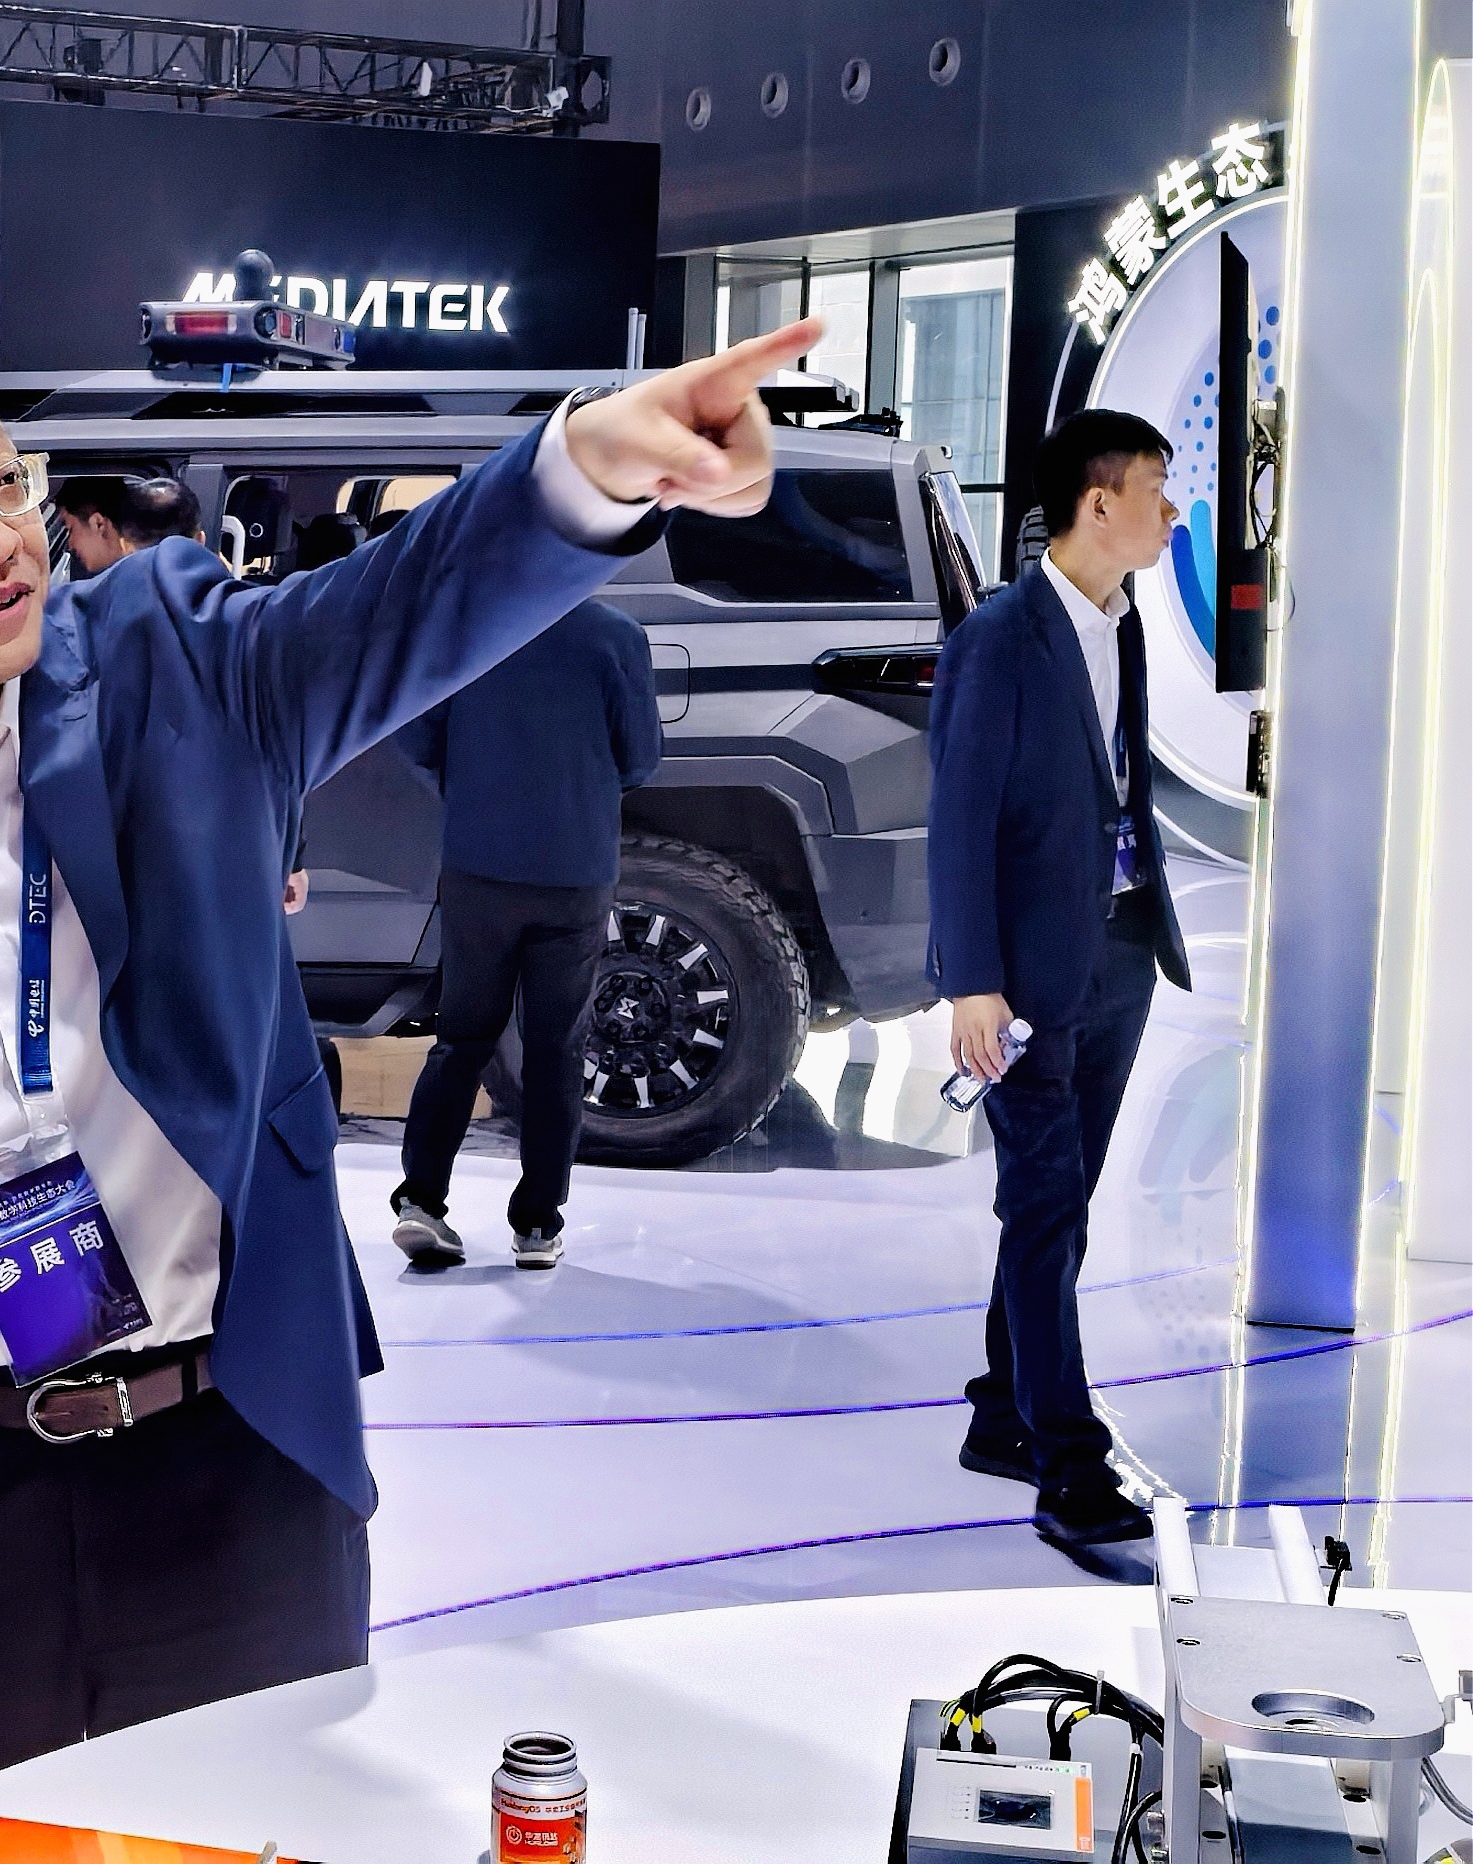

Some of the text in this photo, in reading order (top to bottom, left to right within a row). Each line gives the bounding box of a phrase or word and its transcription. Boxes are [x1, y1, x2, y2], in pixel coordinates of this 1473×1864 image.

[1068, 121, 1270, 346] 鸿蒙生态
[182, 272, 510, 333] MDIATEK
[29, 873, 47, 924] DTEC
